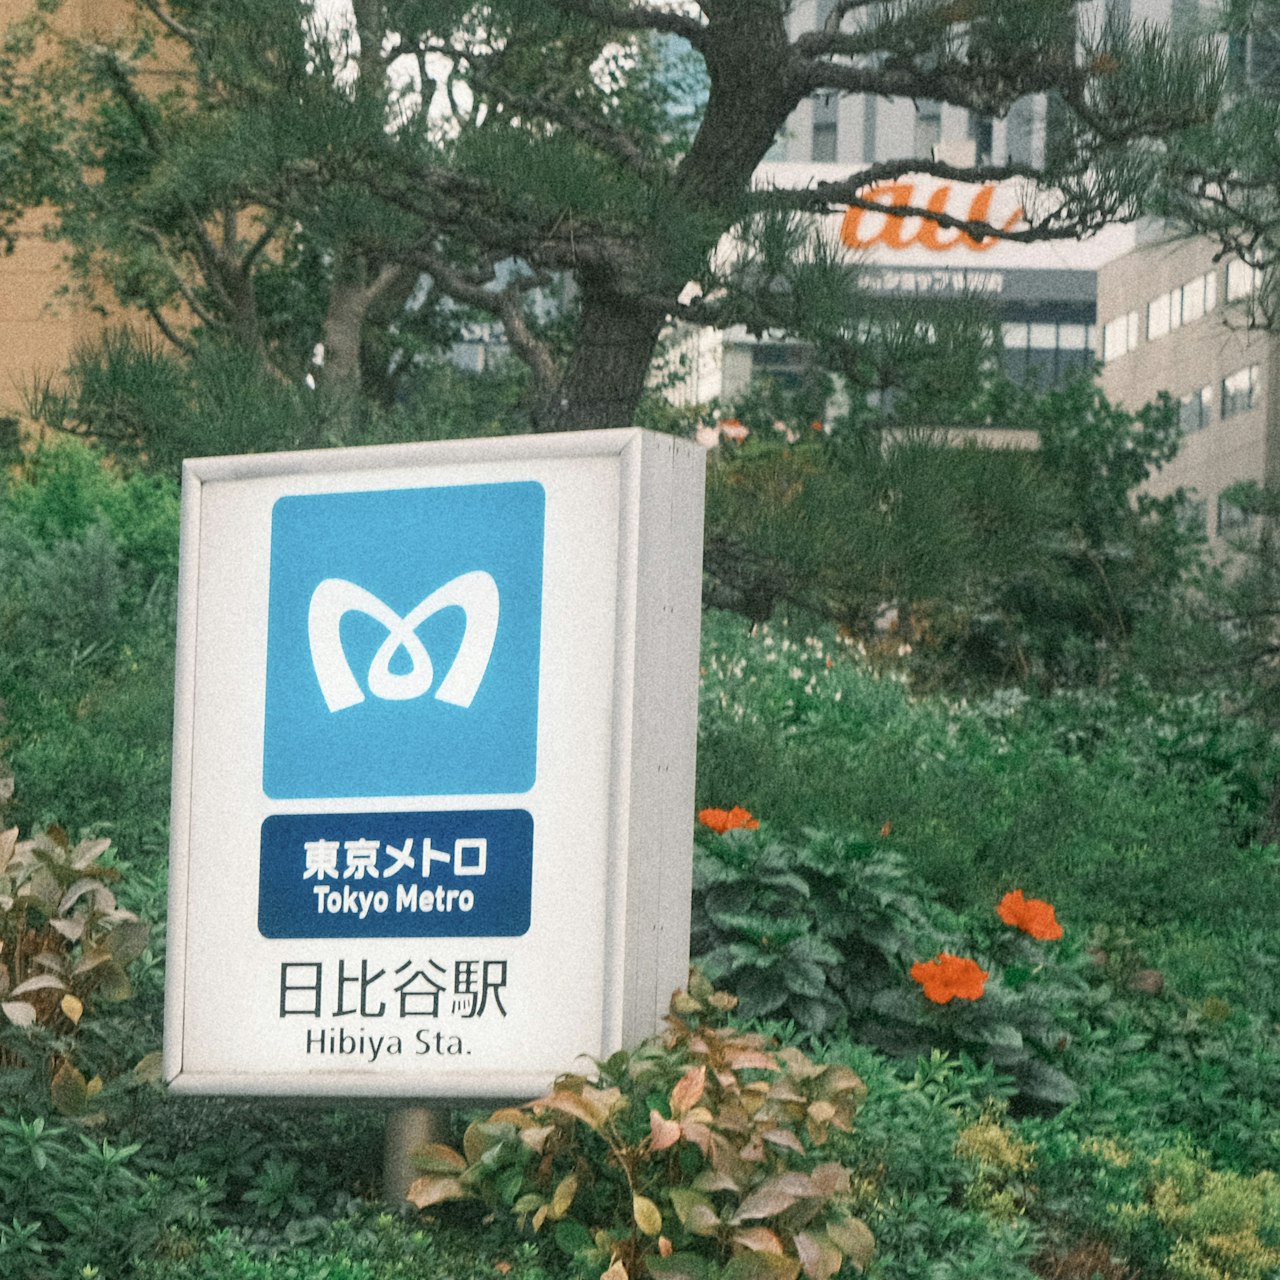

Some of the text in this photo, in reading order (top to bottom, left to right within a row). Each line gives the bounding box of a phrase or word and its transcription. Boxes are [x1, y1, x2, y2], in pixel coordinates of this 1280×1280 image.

[841, 183, 1024, 252] au
[302, 837, 488, 881] 東京メトロ
[313, 883, 475, 919] Tokyo Metro
[279, 958, 508, 1018] 日比谷駅
[306, 1027, 472, 1062] Hibiya Sta.
